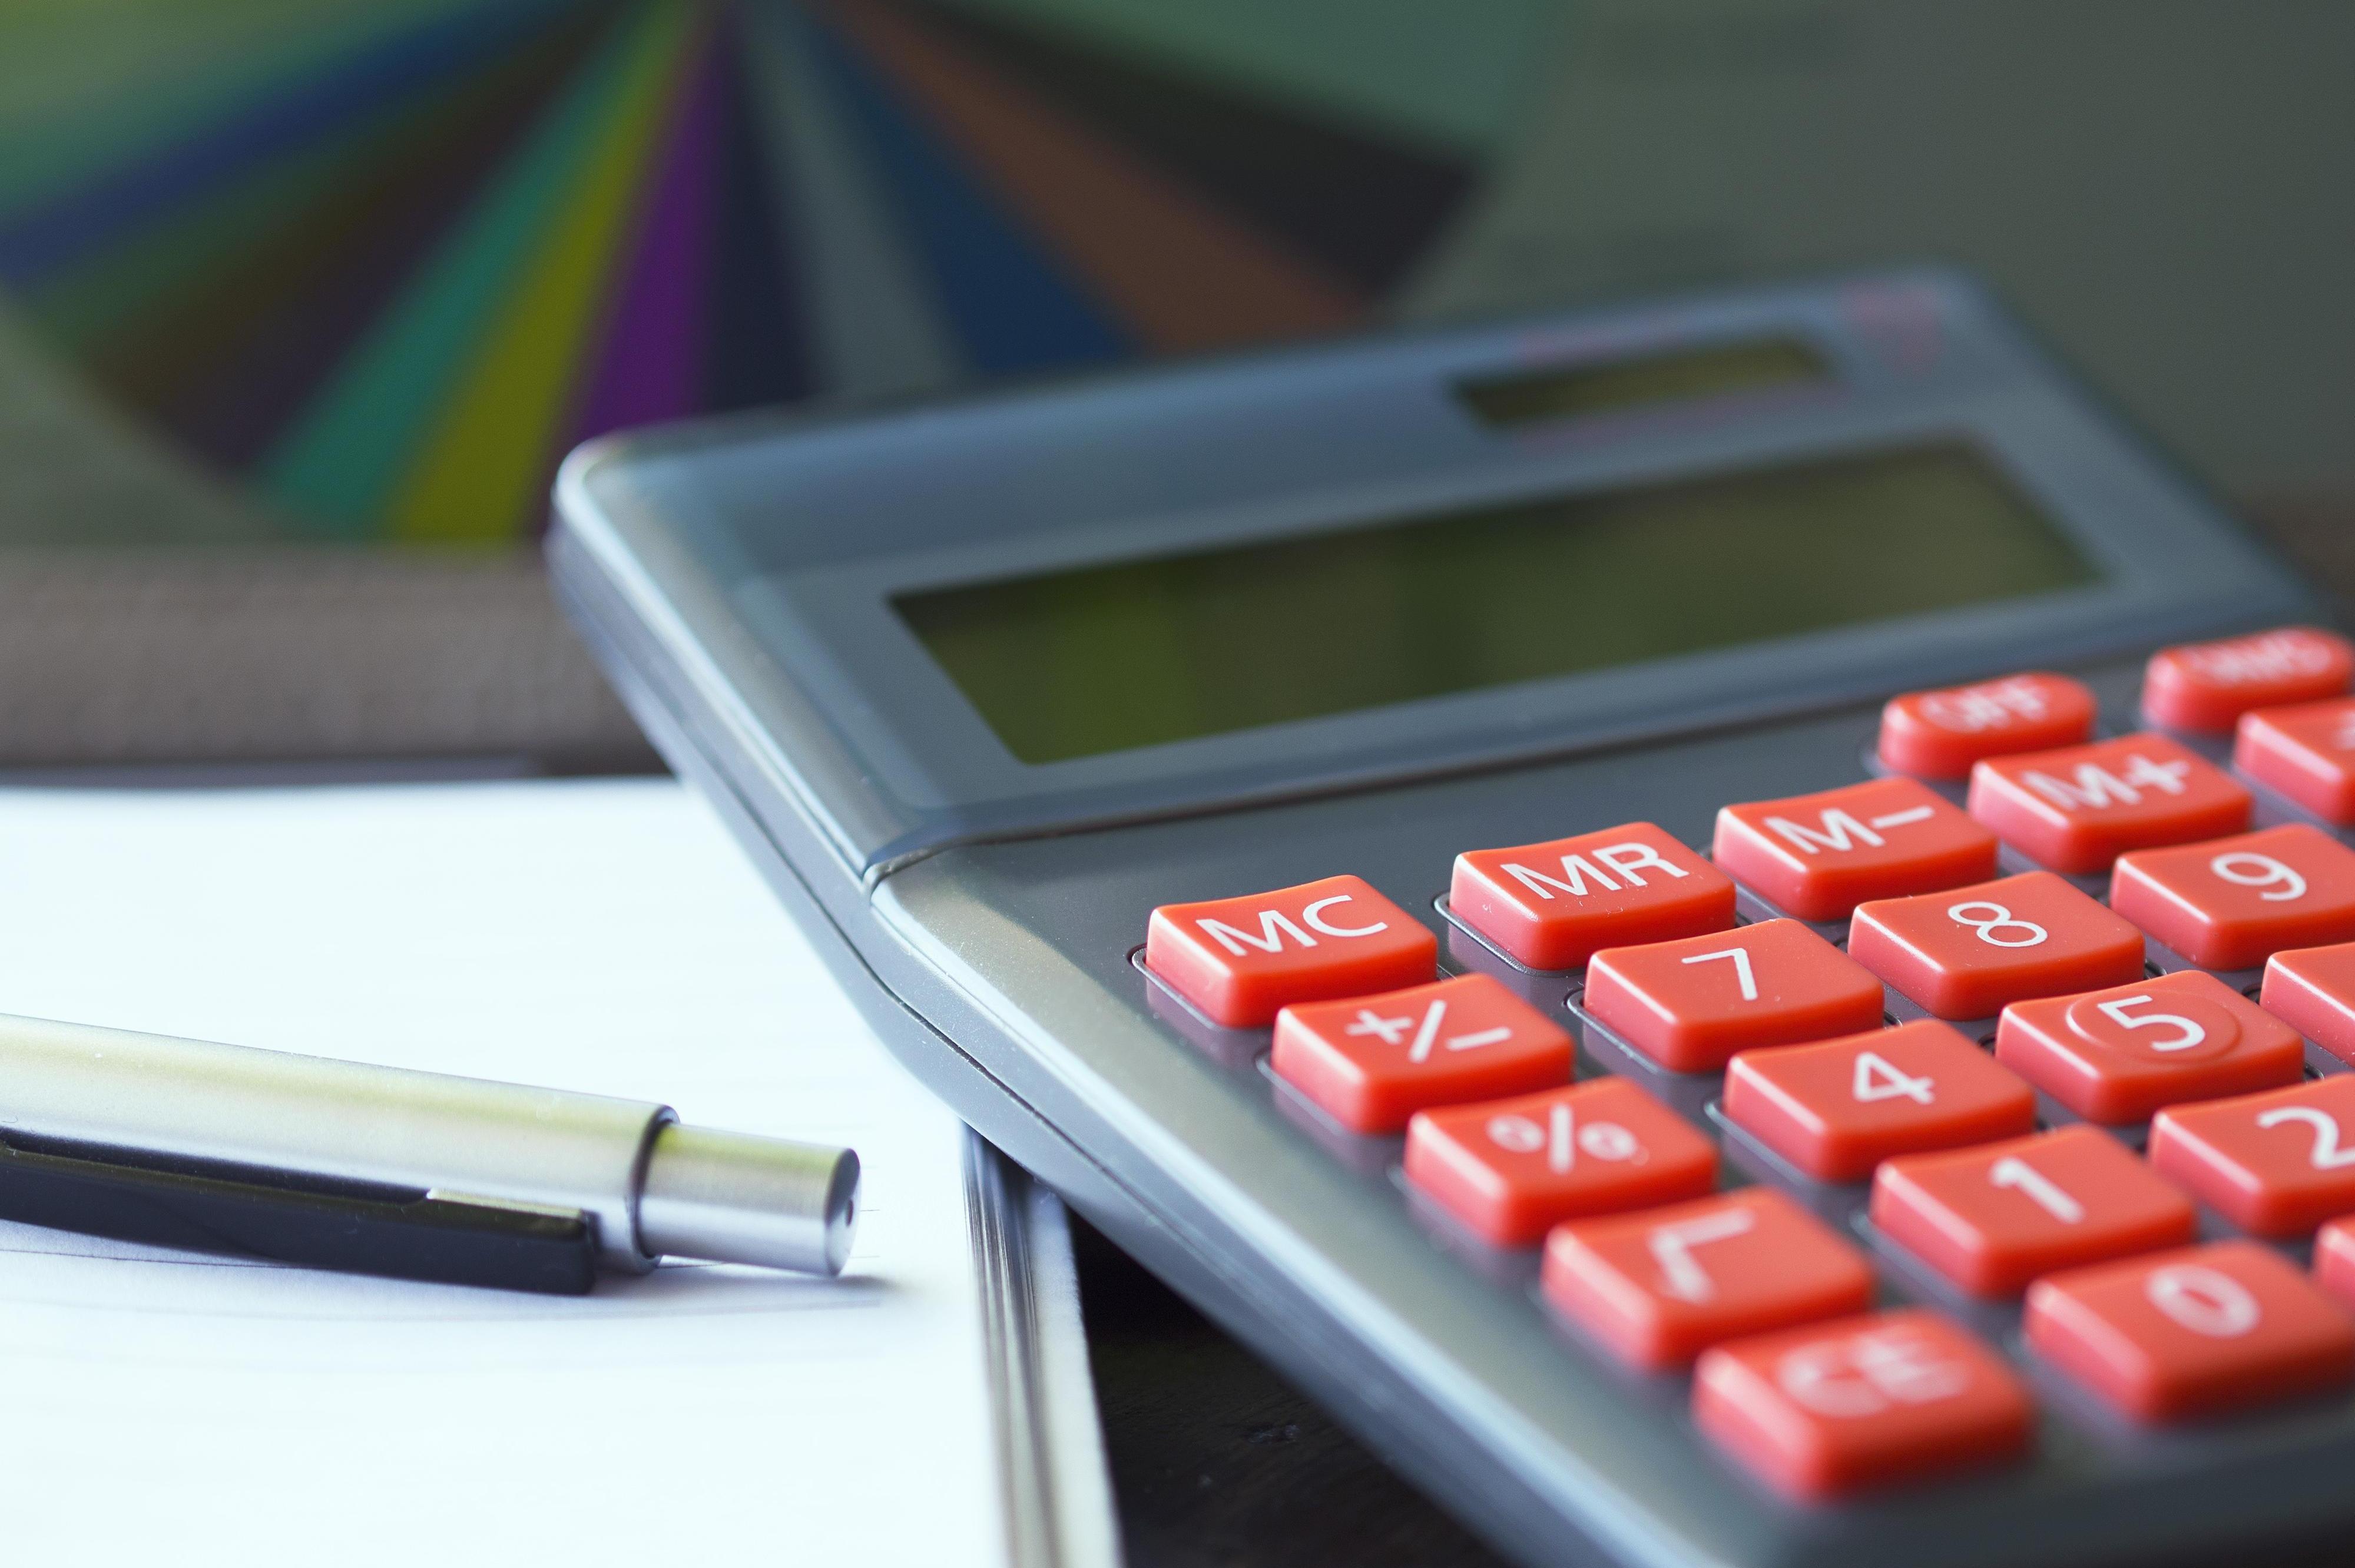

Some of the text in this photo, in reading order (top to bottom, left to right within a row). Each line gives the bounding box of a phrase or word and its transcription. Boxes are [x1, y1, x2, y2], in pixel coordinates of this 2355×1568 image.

[2024, 754, 2190, 810] M+
[1764, 805, 1934, 854] M-
[1501, 843, 1688, 900] MR
[2211, 852, 2307, 901] 9
[1196, 894, 1388, 956] MC
[1947, 901, 2048, 947] 8
[1681, 947, 1758, 1000] 7
[2097, 994, 2205, 1051] 5
[1853, 1052, 1934, 1104] 4
[1487, 1103, 1638, 1174] %
[2257, 1106, 2355, 1169] 2
[1990, 1157, 2084, 1223] 1
[2145, 1265, 2260, 1335] 0
